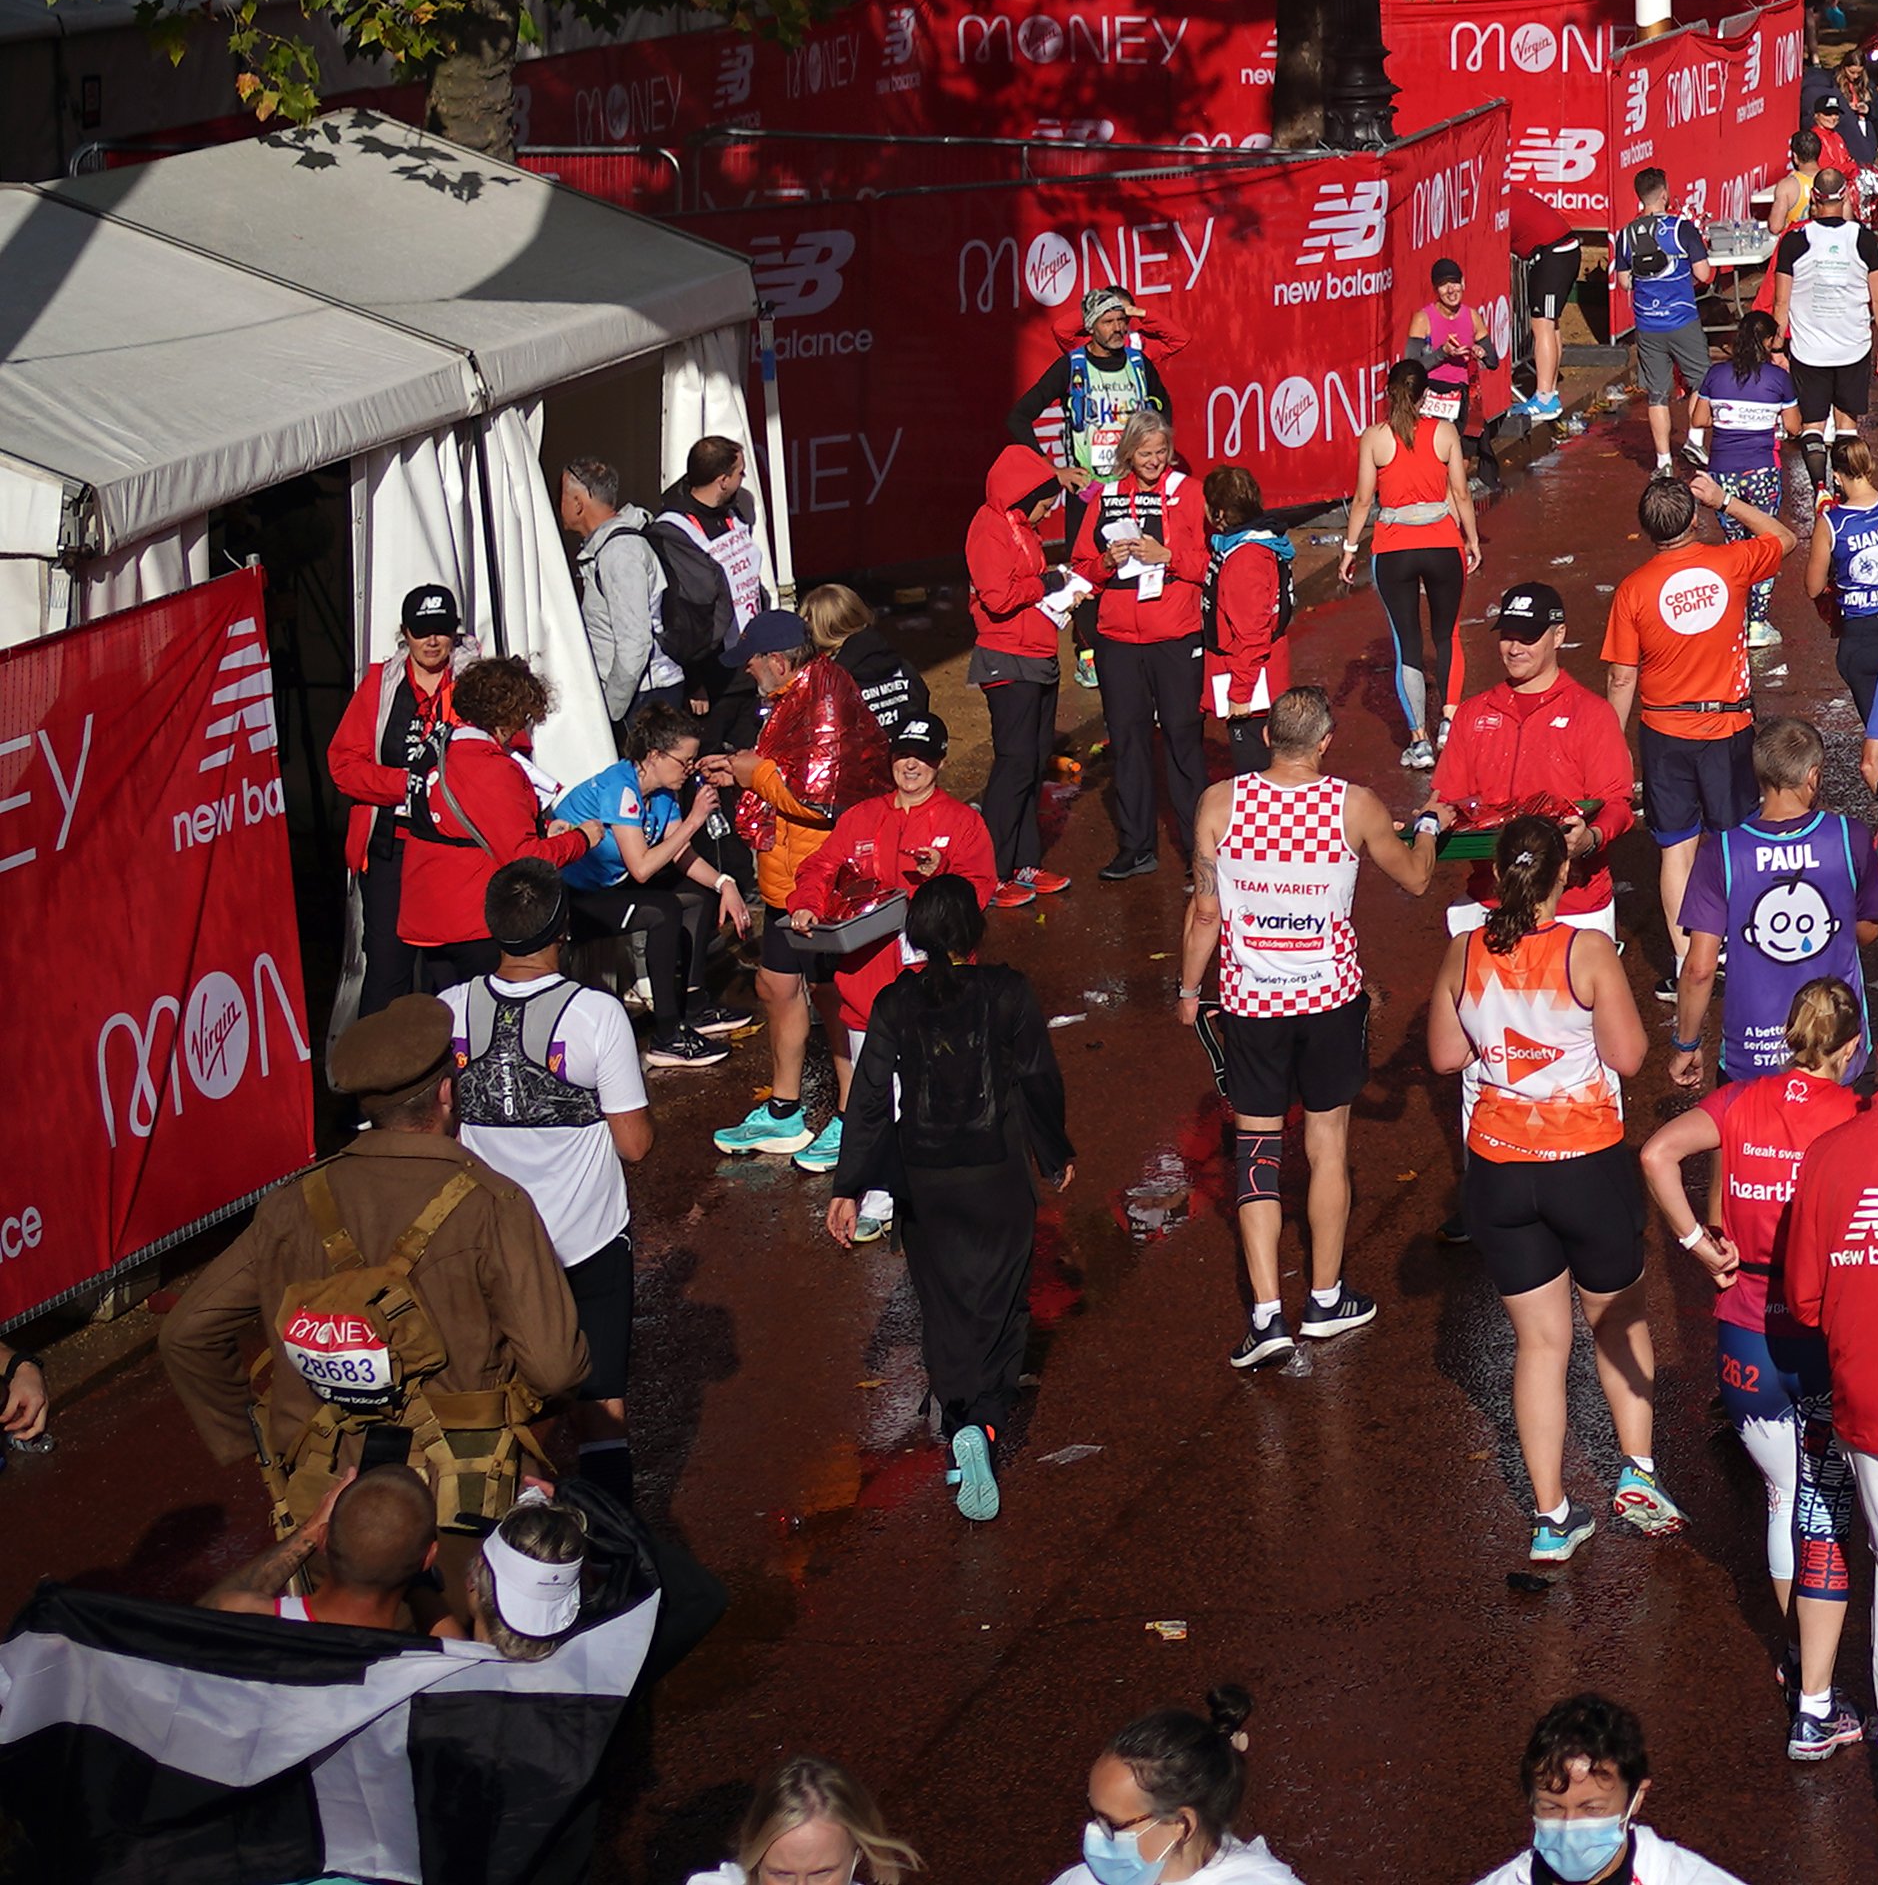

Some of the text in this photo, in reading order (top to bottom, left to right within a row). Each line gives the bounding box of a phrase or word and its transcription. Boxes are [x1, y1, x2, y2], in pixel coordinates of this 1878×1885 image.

[1028, 249, 1072, 293] Virgin
[1274, 265, 1393, 306] new balance
[1271, 391, 1315, 429] Virgin
[1665, 582, 1720, 607] centre
[1672, 592, 1716, 619] point
[173, 795, 237, 853] new
[1755, 843, 1820, 872] PAUL
[1233, 879, 1330, 896] TEAM VARIETY
[1256, 913, 1326, 935] variety
[1259, 938, 1294, 949] children's
[1295, 937, 1324, 950] charity
[191, 992, 241, 1082] Virgin
[1507, 1046, 1558, 1062] Society
[1743, 1142, 1777, 1158] Break
[1830, 1248, 1865, 1267] new
[296, 1352, 376, 1383] 28683
[1722, 1352, 1760, 1393] 26.2
